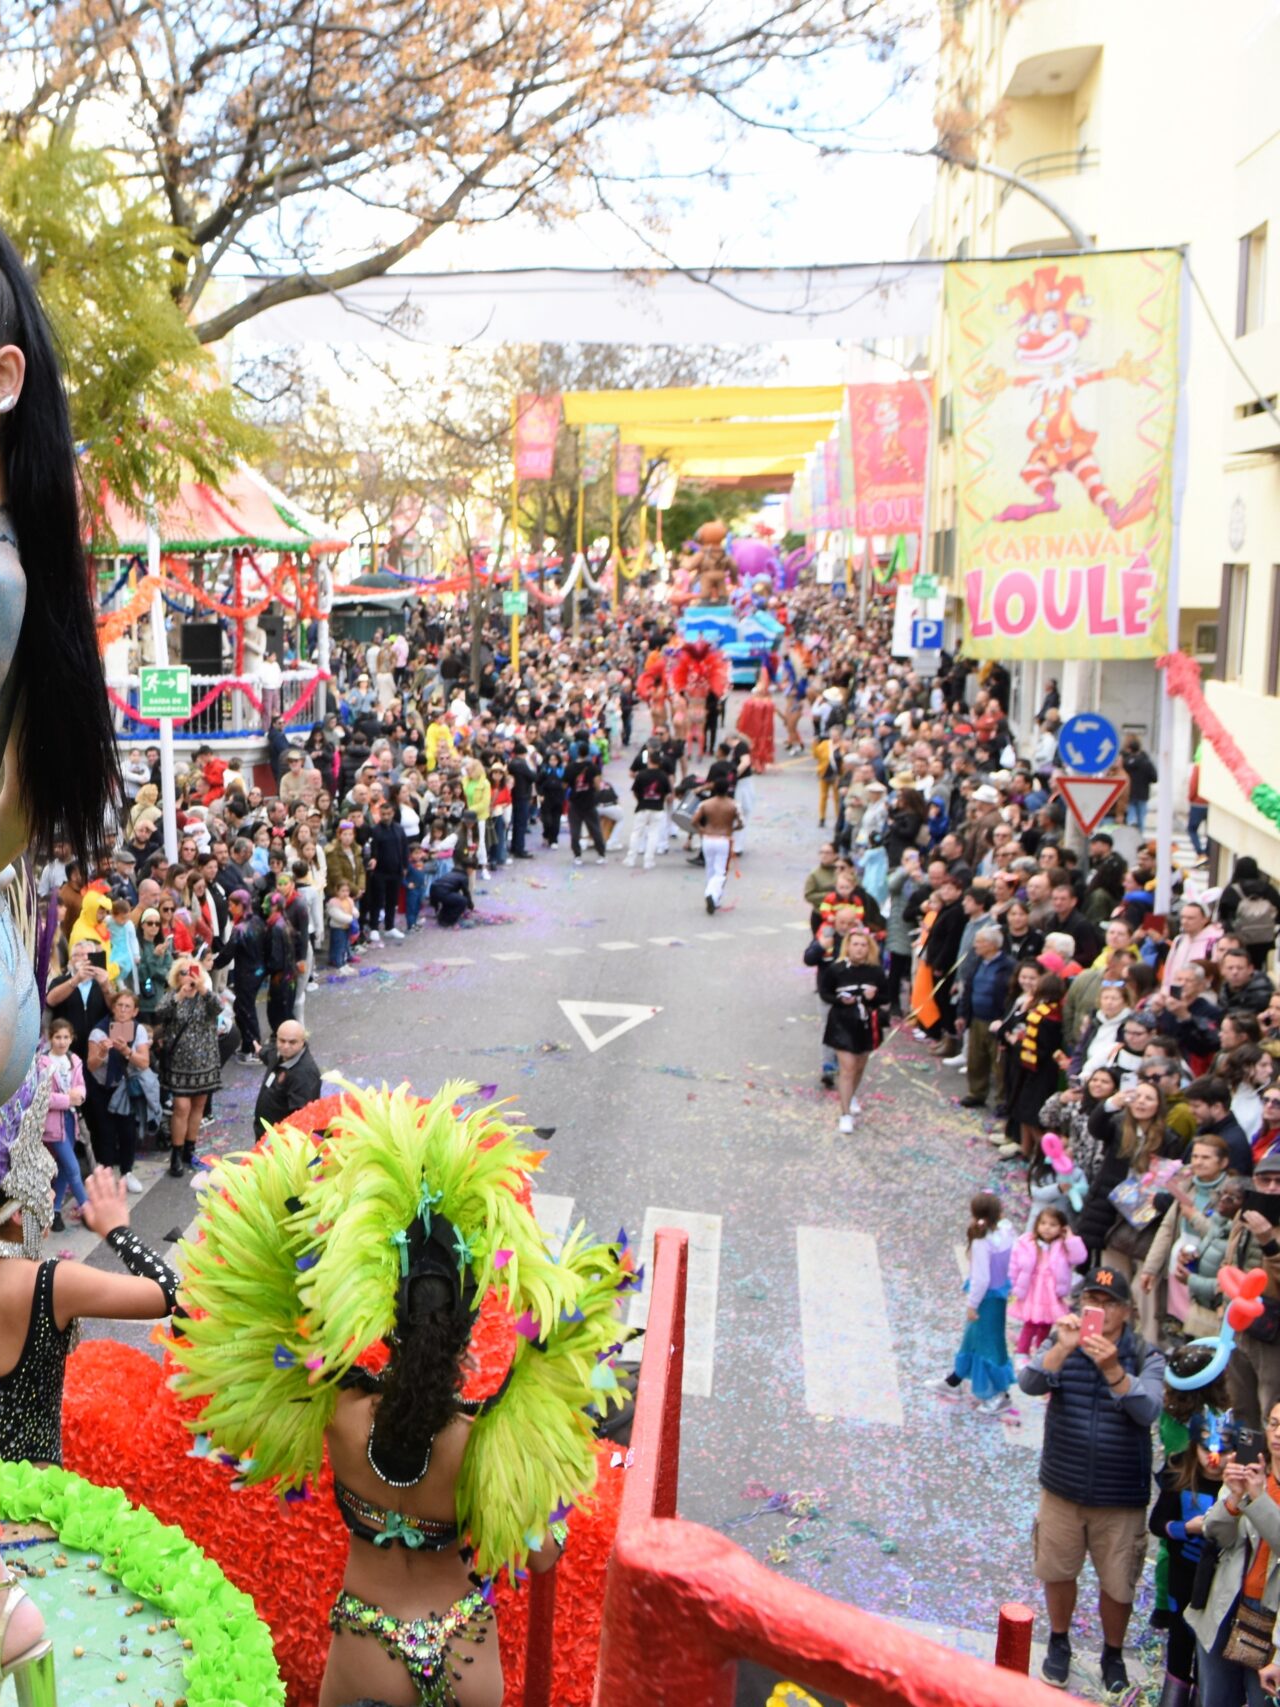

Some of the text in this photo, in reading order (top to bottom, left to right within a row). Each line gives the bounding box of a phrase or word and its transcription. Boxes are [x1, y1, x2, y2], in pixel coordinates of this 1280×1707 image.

[860, 497, 924, 529] LOUL
[985, 529, 1137, 564] CARNAVAL
[965, 553, 1154, 638] LOULÉ
[916, 622, 938, 648] P
